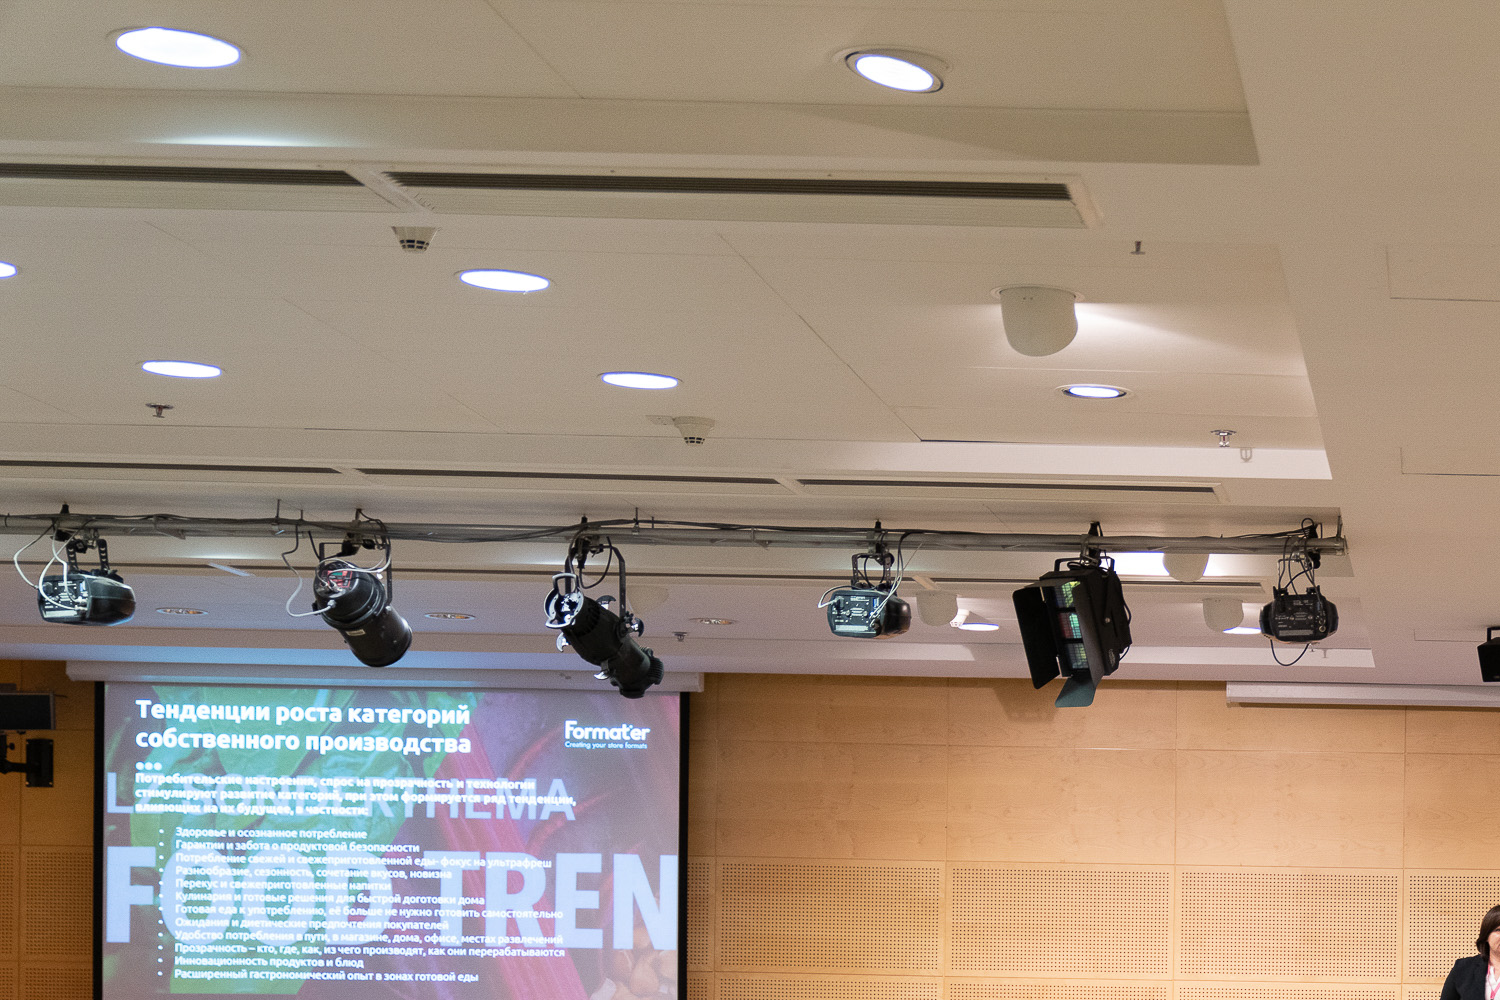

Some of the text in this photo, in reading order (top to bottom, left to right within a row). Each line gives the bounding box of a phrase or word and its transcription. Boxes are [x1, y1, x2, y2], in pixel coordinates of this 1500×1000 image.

[135, 699, 471, 727] Тенденции роста категорий
[136, 726, 471, 756] собственного производства
[564, 741, 591, 750] Creating
[182, 773, 576, 821] SONDERTHEMA
[175, 827, 226, 838] Здоровье
[236, 829, 297, 837] осознанное
[298, 828, 367, 840] потребление
[176, 840, 224, 850] Гарантии
[234, 840, 270, 849] забота
[279, 841, 348, 852] продуктовой
[349, 841, 419, 851] безопасности
[107, 846, 393, 946] FOOD
[174, 968, 248, 980] Расширенный
[248, 969, 345, 981] гастрономический
[414, 971, 456, 980] готовой
[457, 974, 479, 982] еды
